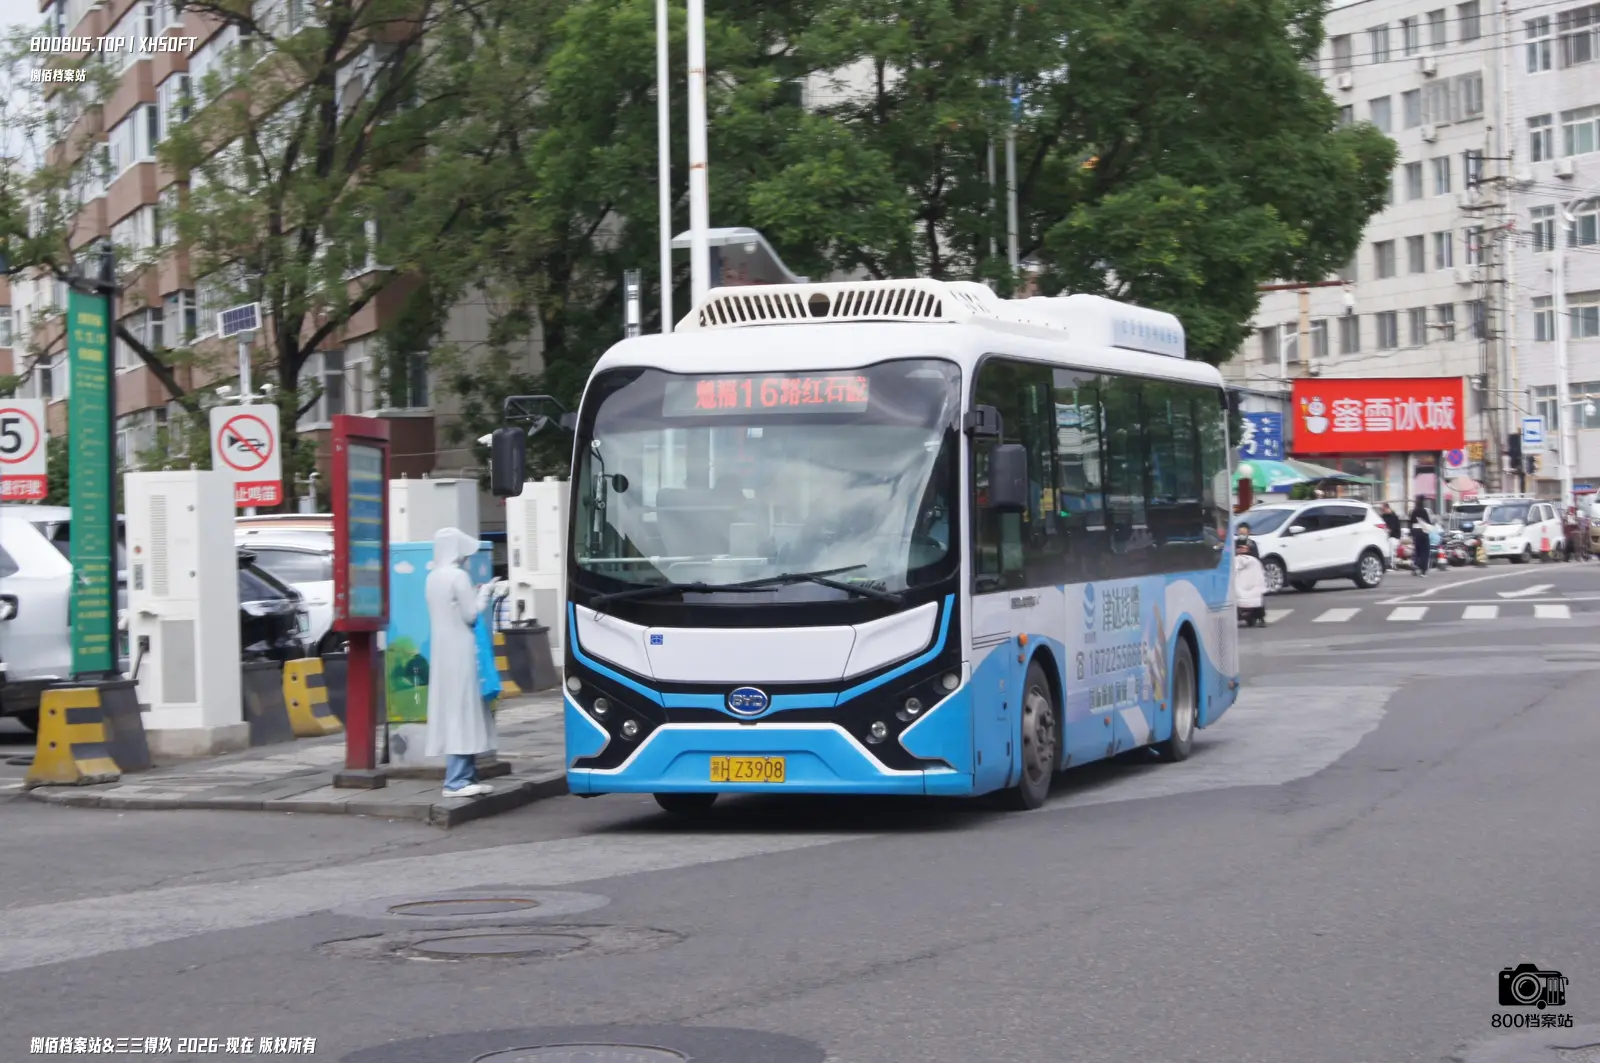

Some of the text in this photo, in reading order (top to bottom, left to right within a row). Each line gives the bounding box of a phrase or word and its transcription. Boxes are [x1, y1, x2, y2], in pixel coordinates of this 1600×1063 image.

[1332, 396, 1456, 432] 蜜雪冰城
[732, 694, 763, 707] BYD
